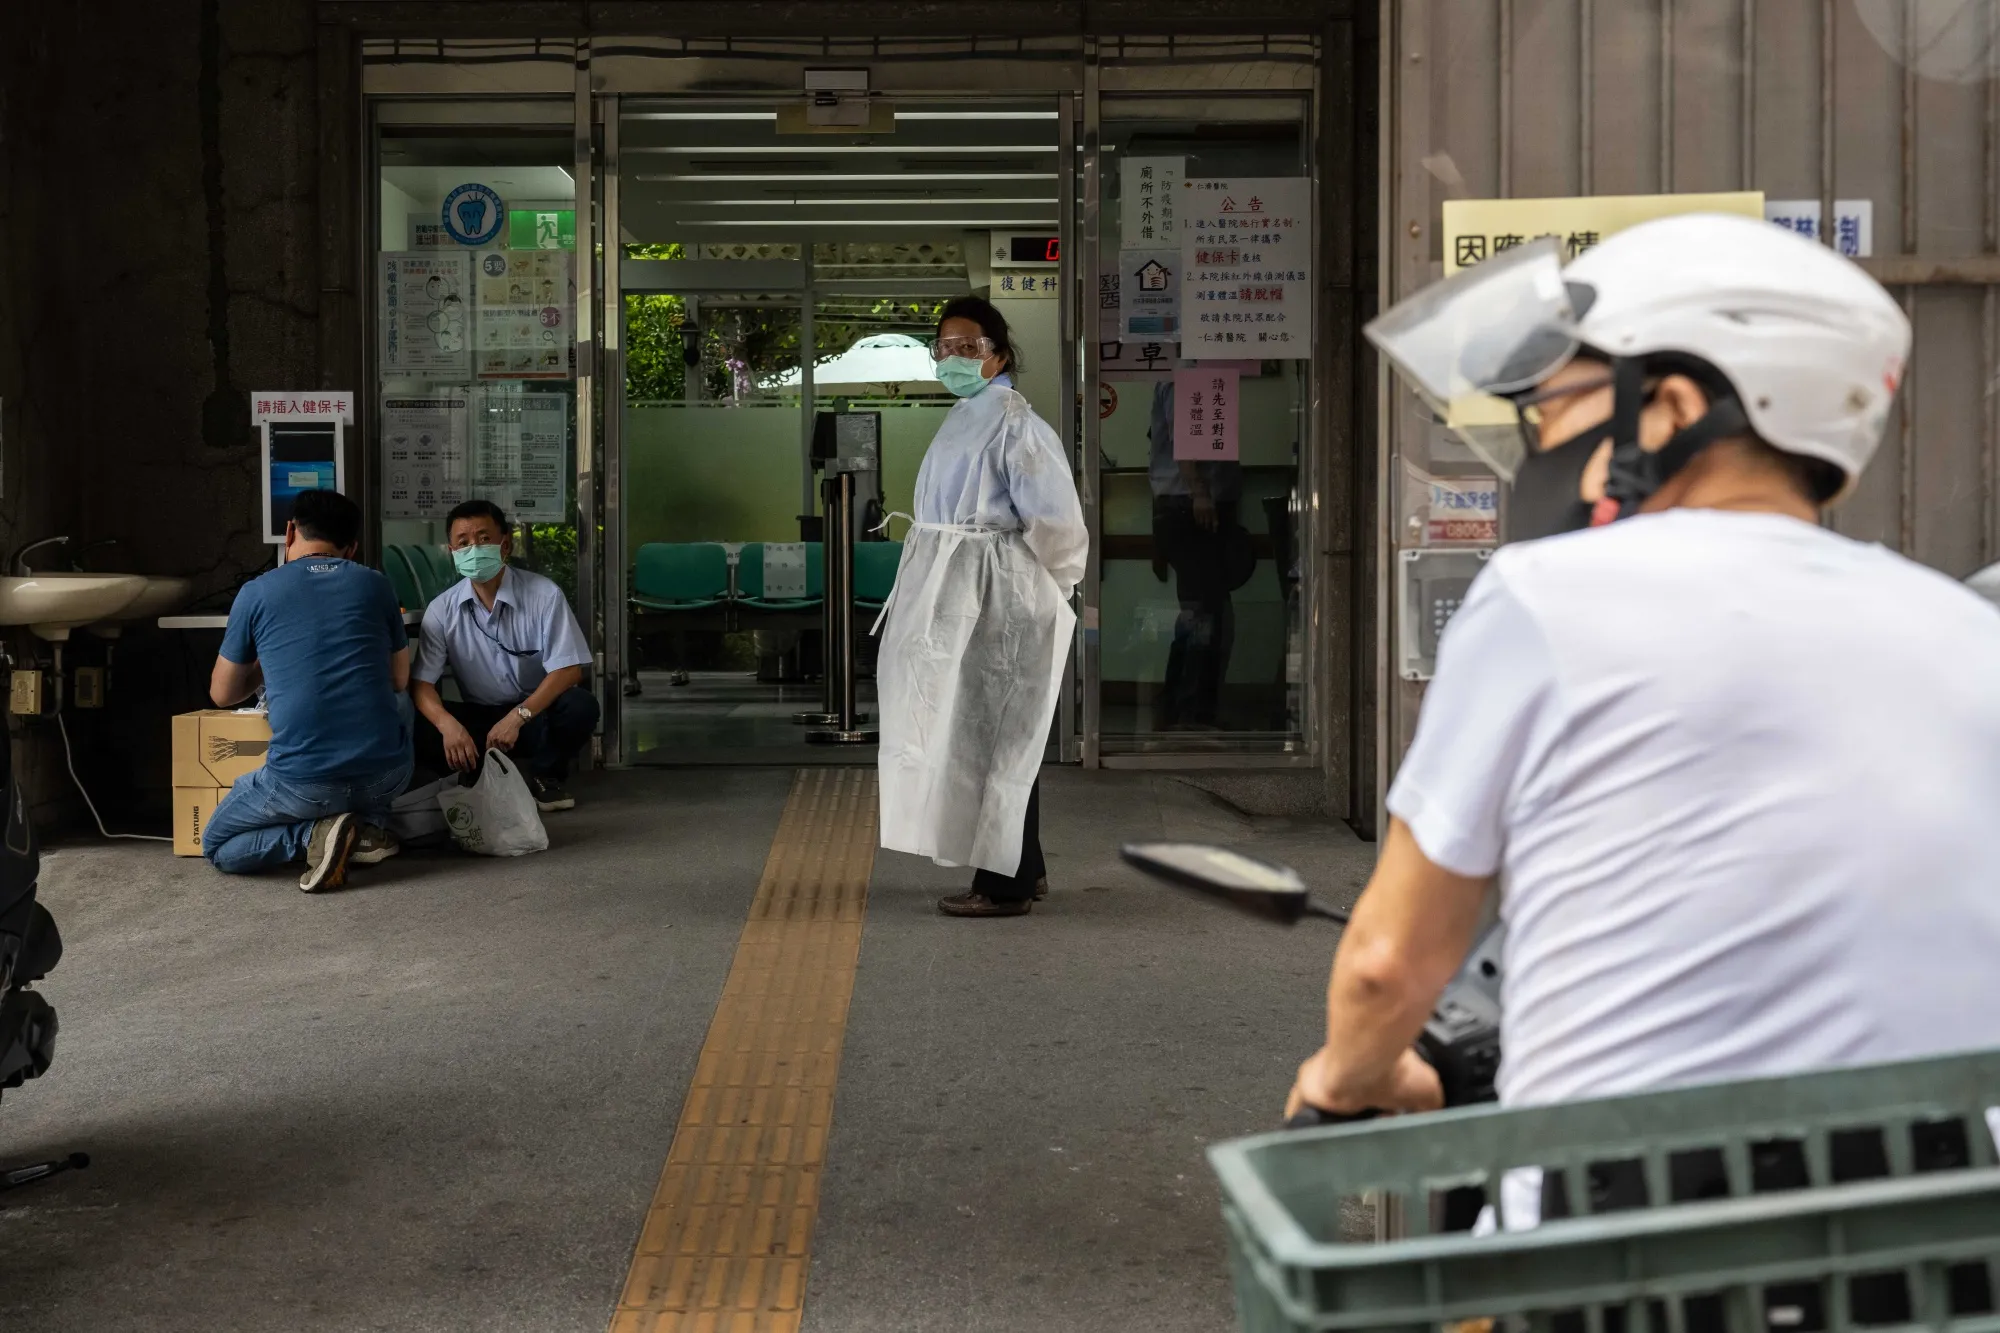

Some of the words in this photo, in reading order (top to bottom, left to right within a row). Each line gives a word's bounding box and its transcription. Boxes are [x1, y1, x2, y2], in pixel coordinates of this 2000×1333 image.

[1140, 166, 1155, 239] 廁所不外借
[1220, 196, 1263, 211] 公告
[1001, 276, 1057, 291] 復健科
[1195, 286, 1283, 301] 測量體溫請脫帽
[1200, 313, 1286, 324] 敬請來院民眾配合
[257, 400, 347, 415] 請插入健保卡
[1189, 391, 1204, 436] 量體溫
[1212, 378, 1226, 451] 請先至對面
